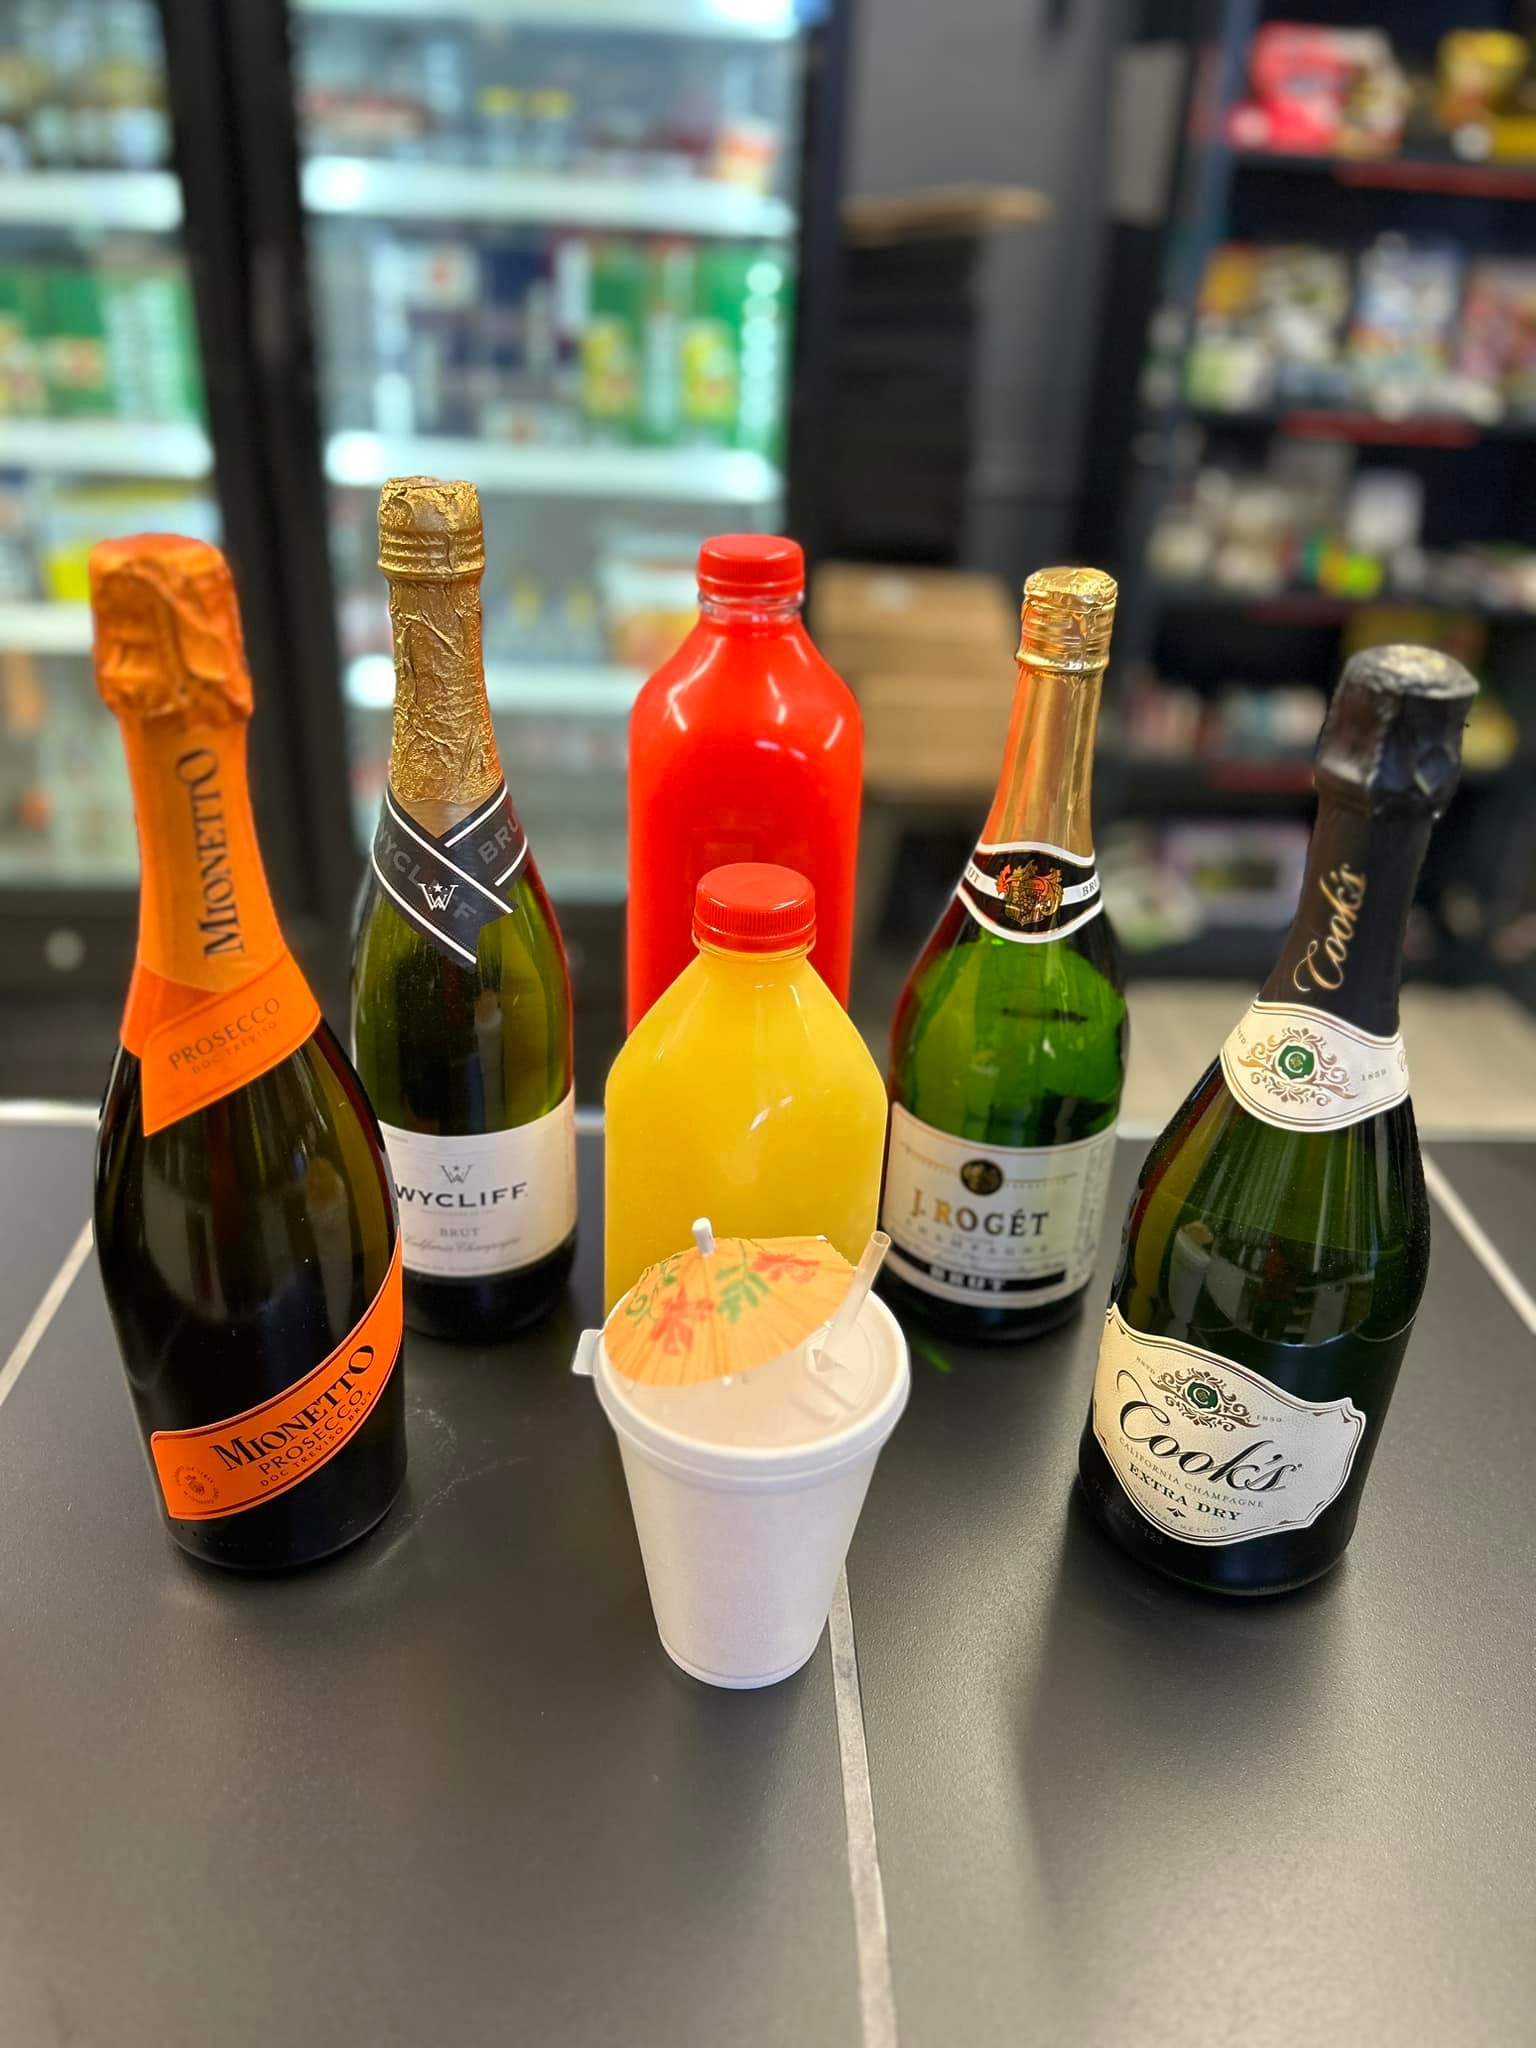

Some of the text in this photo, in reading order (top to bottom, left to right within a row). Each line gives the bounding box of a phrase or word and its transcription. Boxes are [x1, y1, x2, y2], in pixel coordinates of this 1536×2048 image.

[1293, 863, 1367, 993] Cook's
[168, 996, 282, 1072] PROSECCO
[395, 1182, 527, 1208] WYCLIFF
[440, 1227, 480, 1237] BRUT
[934, 1198, 1049, 1237] ROGÉT
[258, 1389, 363, 1476] PROSECCO
[259, 1390, 373, 1488] DOC TREVISO BRUT
[1117, 1369, 1302, 1492] Cook's
[1119, 1437, 1265, 1509] CALIFORNIA CHAMPAGNE
[1128, 1462, 1243, 1522] EXTRA DRY
